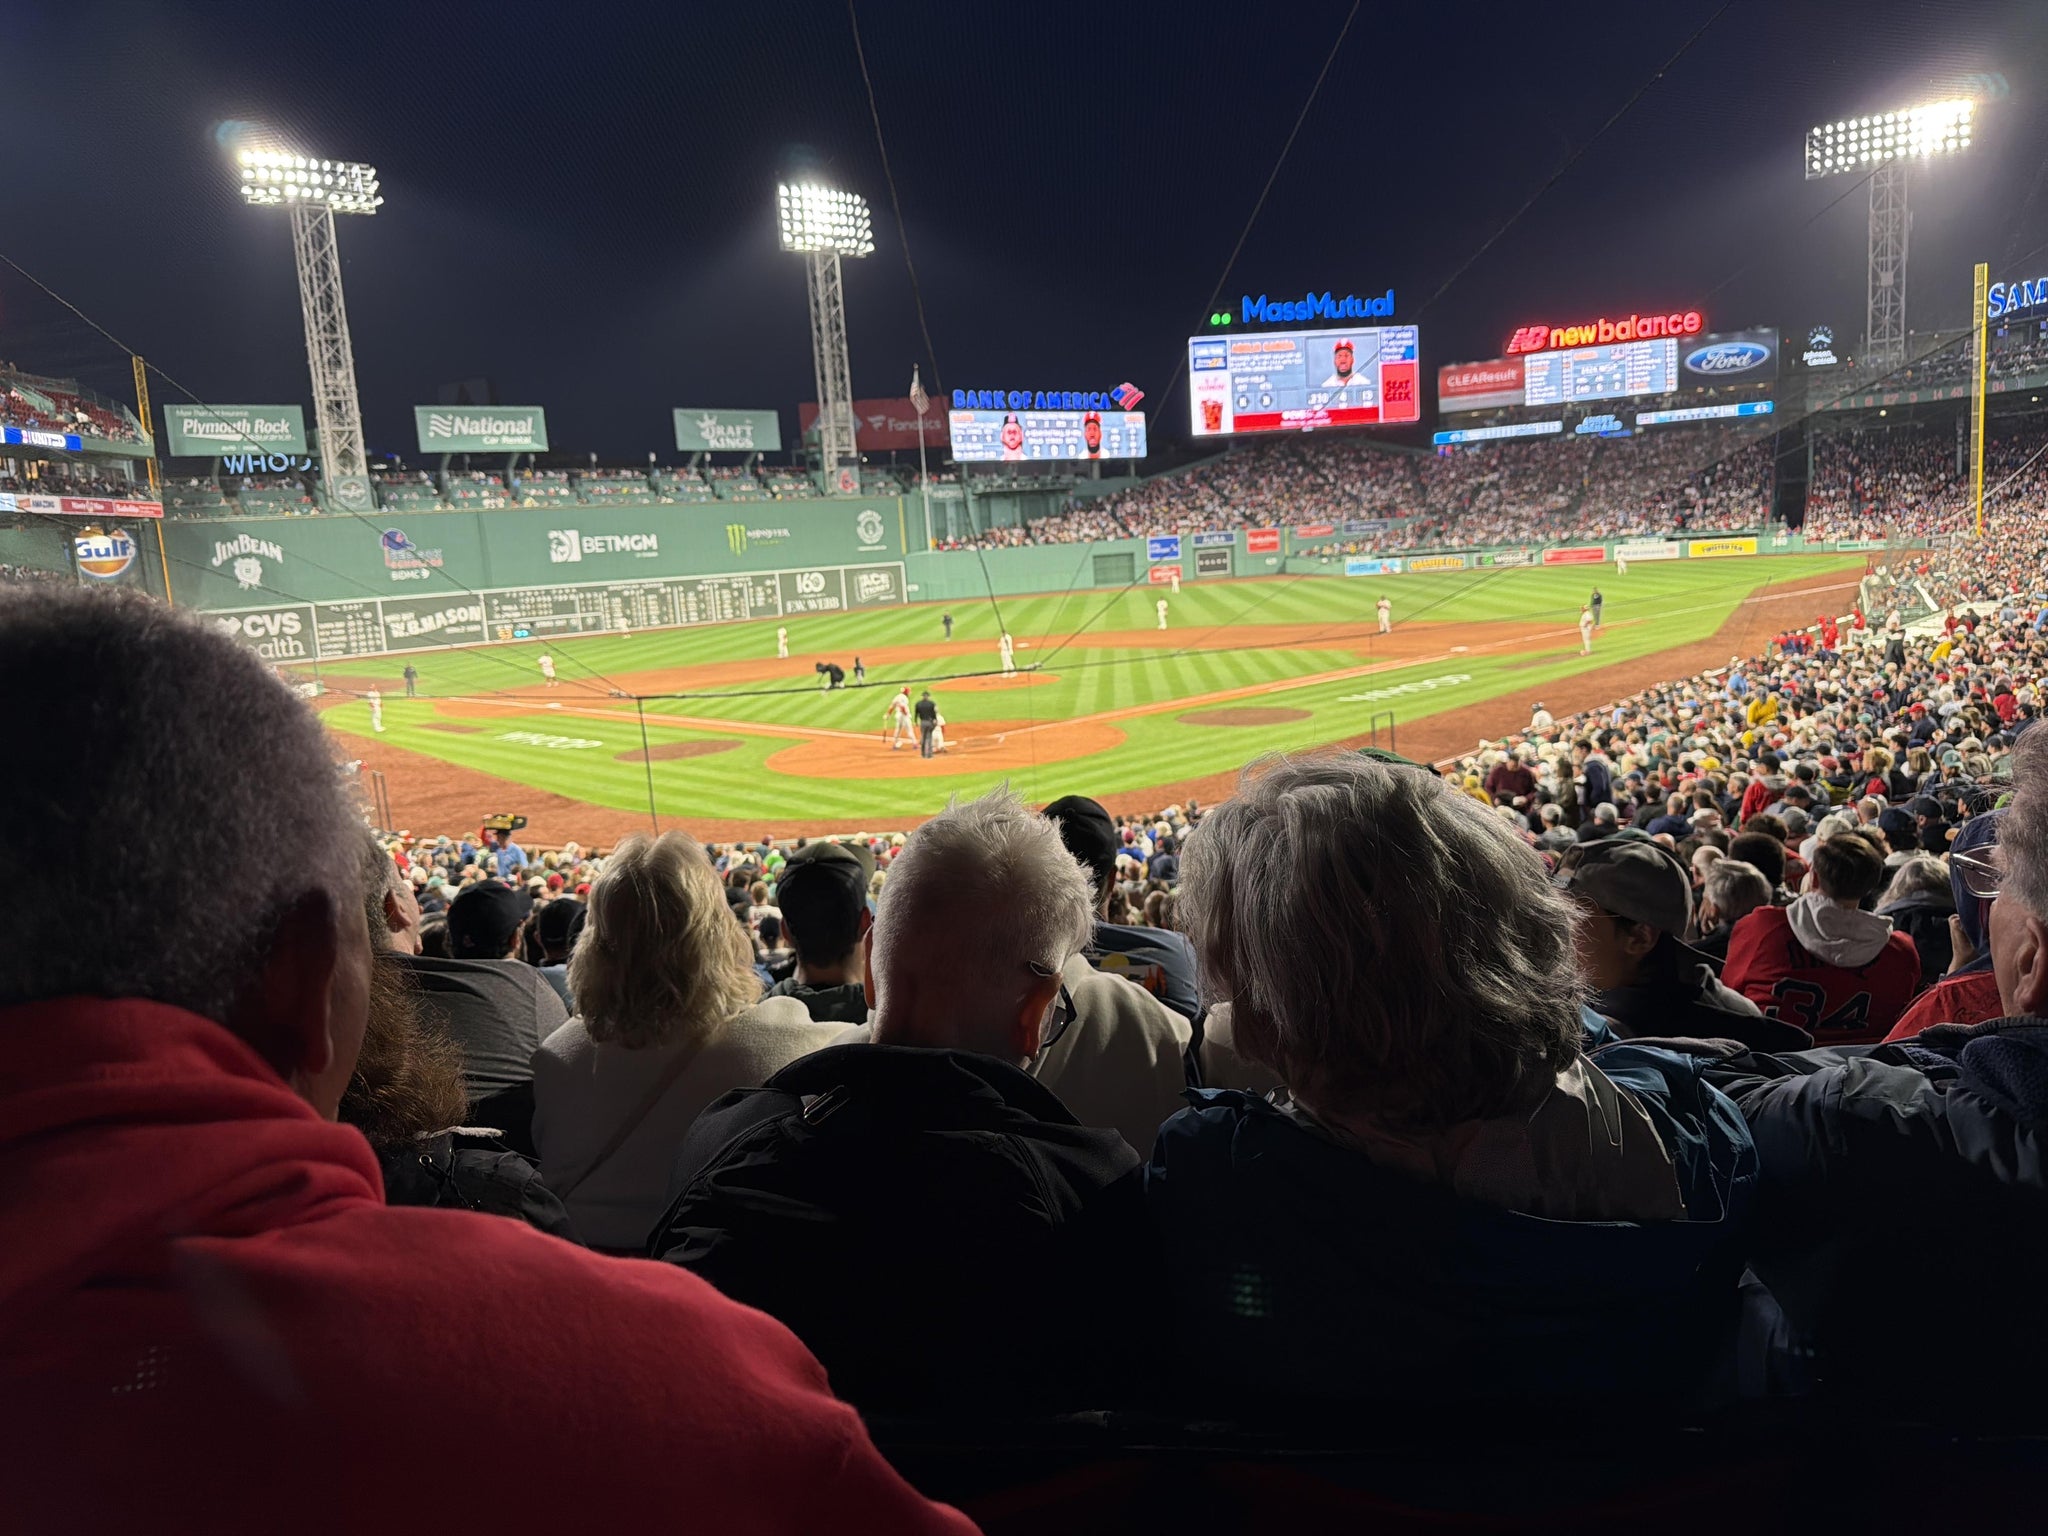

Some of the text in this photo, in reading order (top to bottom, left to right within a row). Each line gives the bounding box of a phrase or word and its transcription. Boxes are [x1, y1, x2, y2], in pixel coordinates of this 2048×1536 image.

[1242, 289, 1395, 323] MassMutual
[1988, 277, 2048, 318] SAM
[1551, 325, 1597, 348] new
[1599, 312, 1703, 343] balance
[1702, 350, 1752, 370] Ford
[1447, 369, 1519, 387] CLEAResult
[952, 389, 1112, 410] BANK OF AMERICA
[183, 418, 290, 436] Plymouth Rock
[453, 416, 533, 435] National
[482, 436, 532, 445] Car Rental
[76, 540, 132, 559] Gulf
[211, 533, 284, 567] JIM BEAM
[582, 534, 658, 553] BETMGM
[796, 572, 826, 594] 160
[243, 612, 302, 638] CVS
[1765, 977, 1872, 1030] 34
